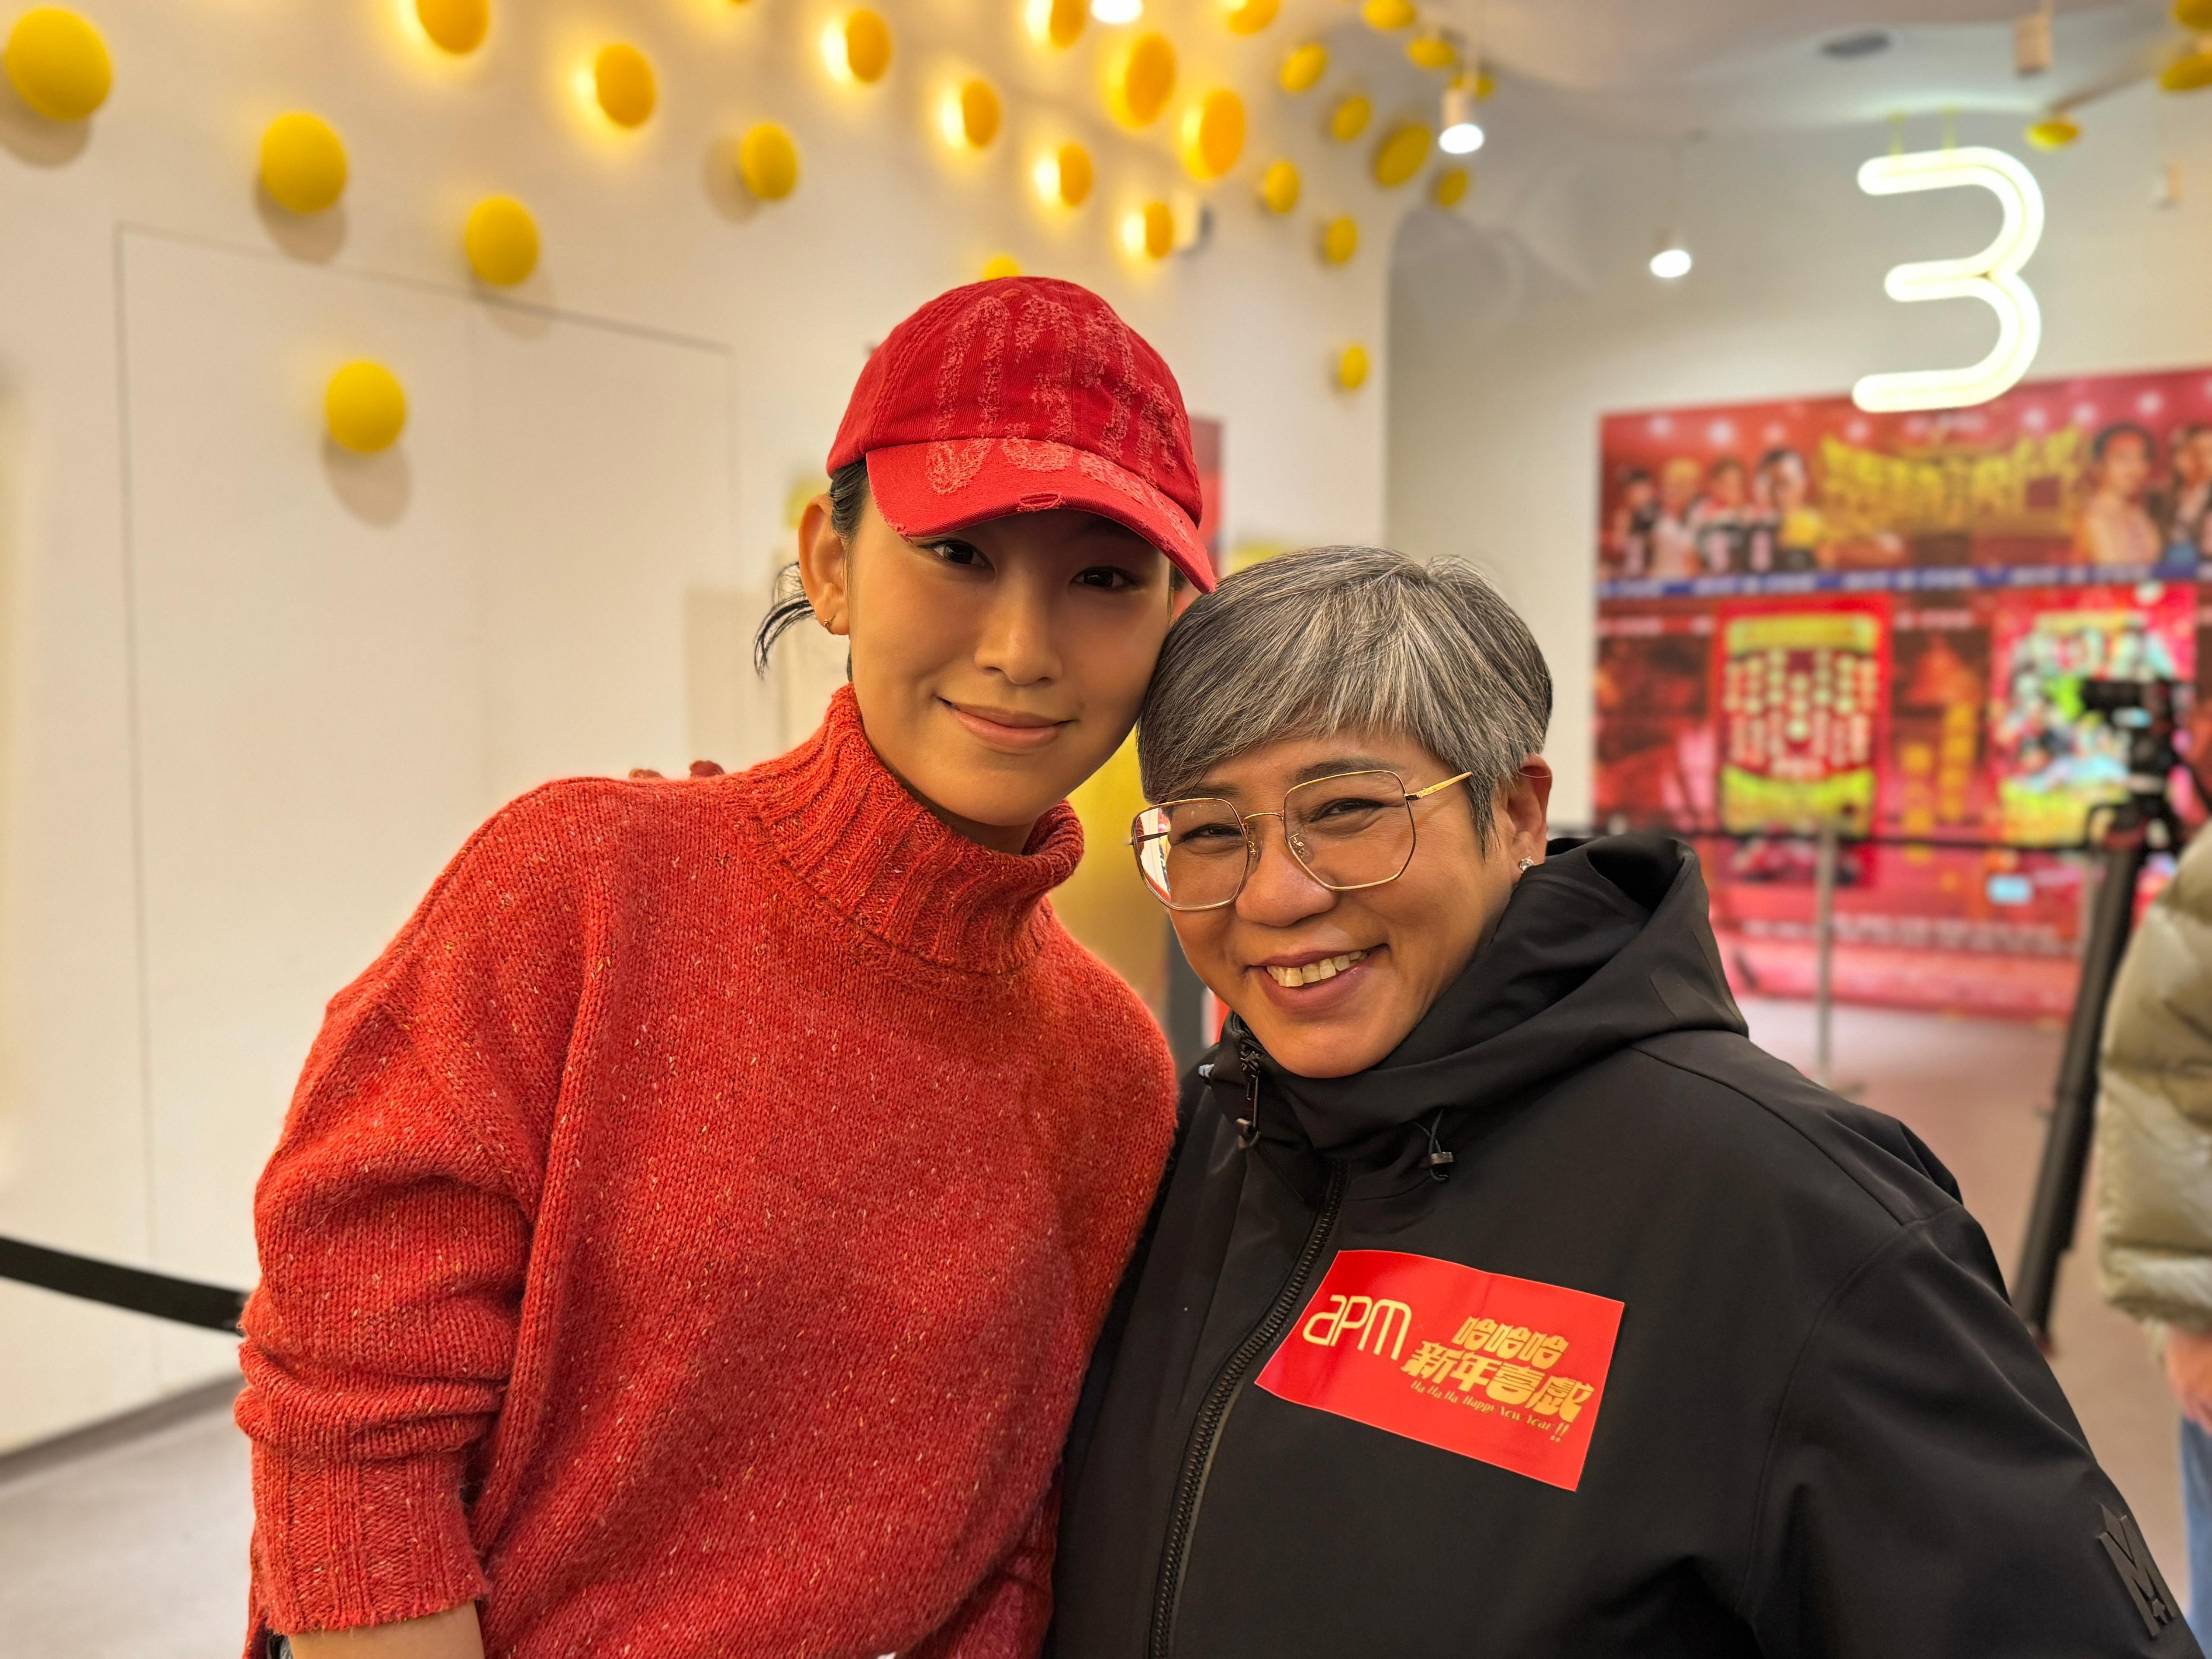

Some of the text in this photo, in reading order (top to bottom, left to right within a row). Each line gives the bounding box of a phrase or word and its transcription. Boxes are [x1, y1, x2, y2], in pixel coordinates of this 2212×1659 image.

[1852, 146, 2045, 413] 3
[1451, 1316, 1569, 1370] 哈哈哈
[1410, 1380, 1425, 1393] Ha
[1427, 1385, 1443, 1398] Ha
[1444, 1390, 1459, 1403] Ha
[1462, 1395, 1495, 1413] Happy
[1500, 1405, 1523, 1421] New
